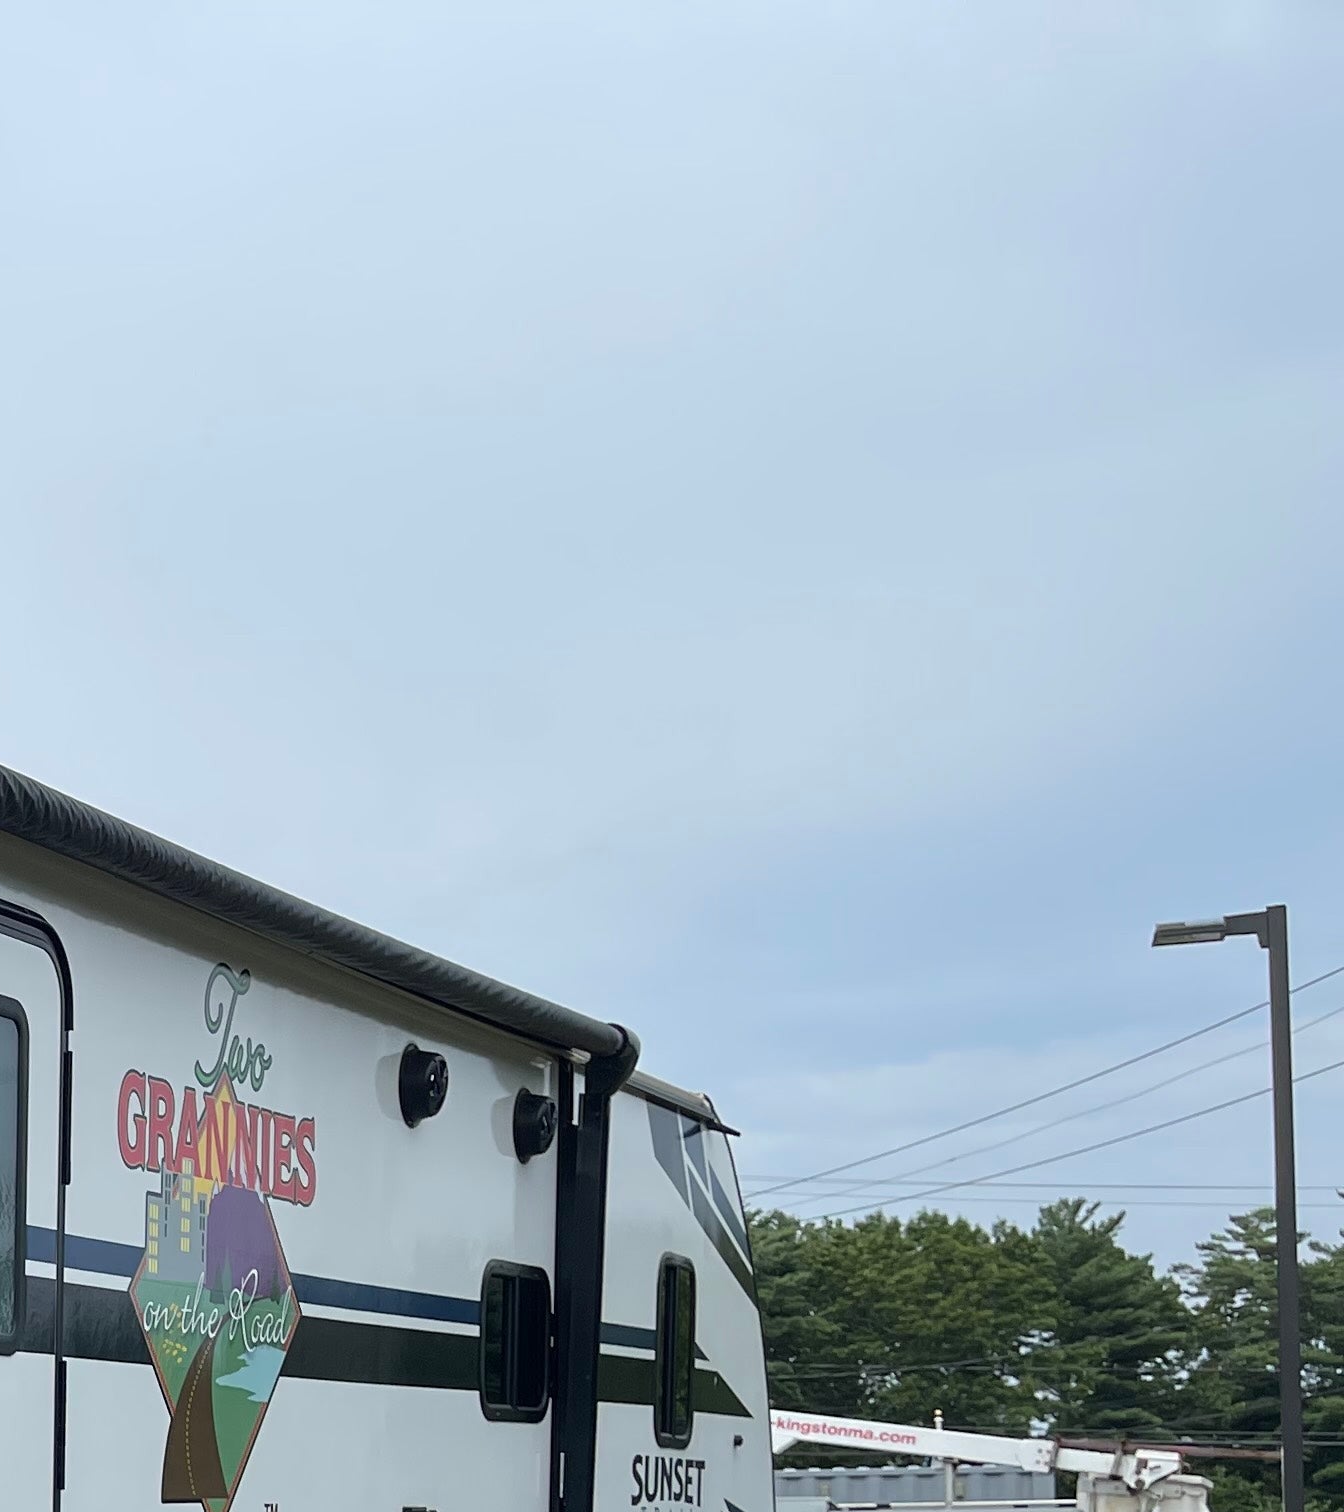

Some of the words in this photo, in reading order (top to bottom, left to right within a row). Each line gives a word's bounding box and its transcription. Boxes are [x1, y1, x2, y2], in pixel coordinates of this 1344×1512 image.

[194, 962, 273, 1093] Two
[117, 1068, 317, 1208] GRANNIES
[143, 1301, 177, 1332] on
[180, 1271, 224, 1339] the
[228, 1268, 292, 1353] Road
[631, 1454, 706, 1507] SUNSET
